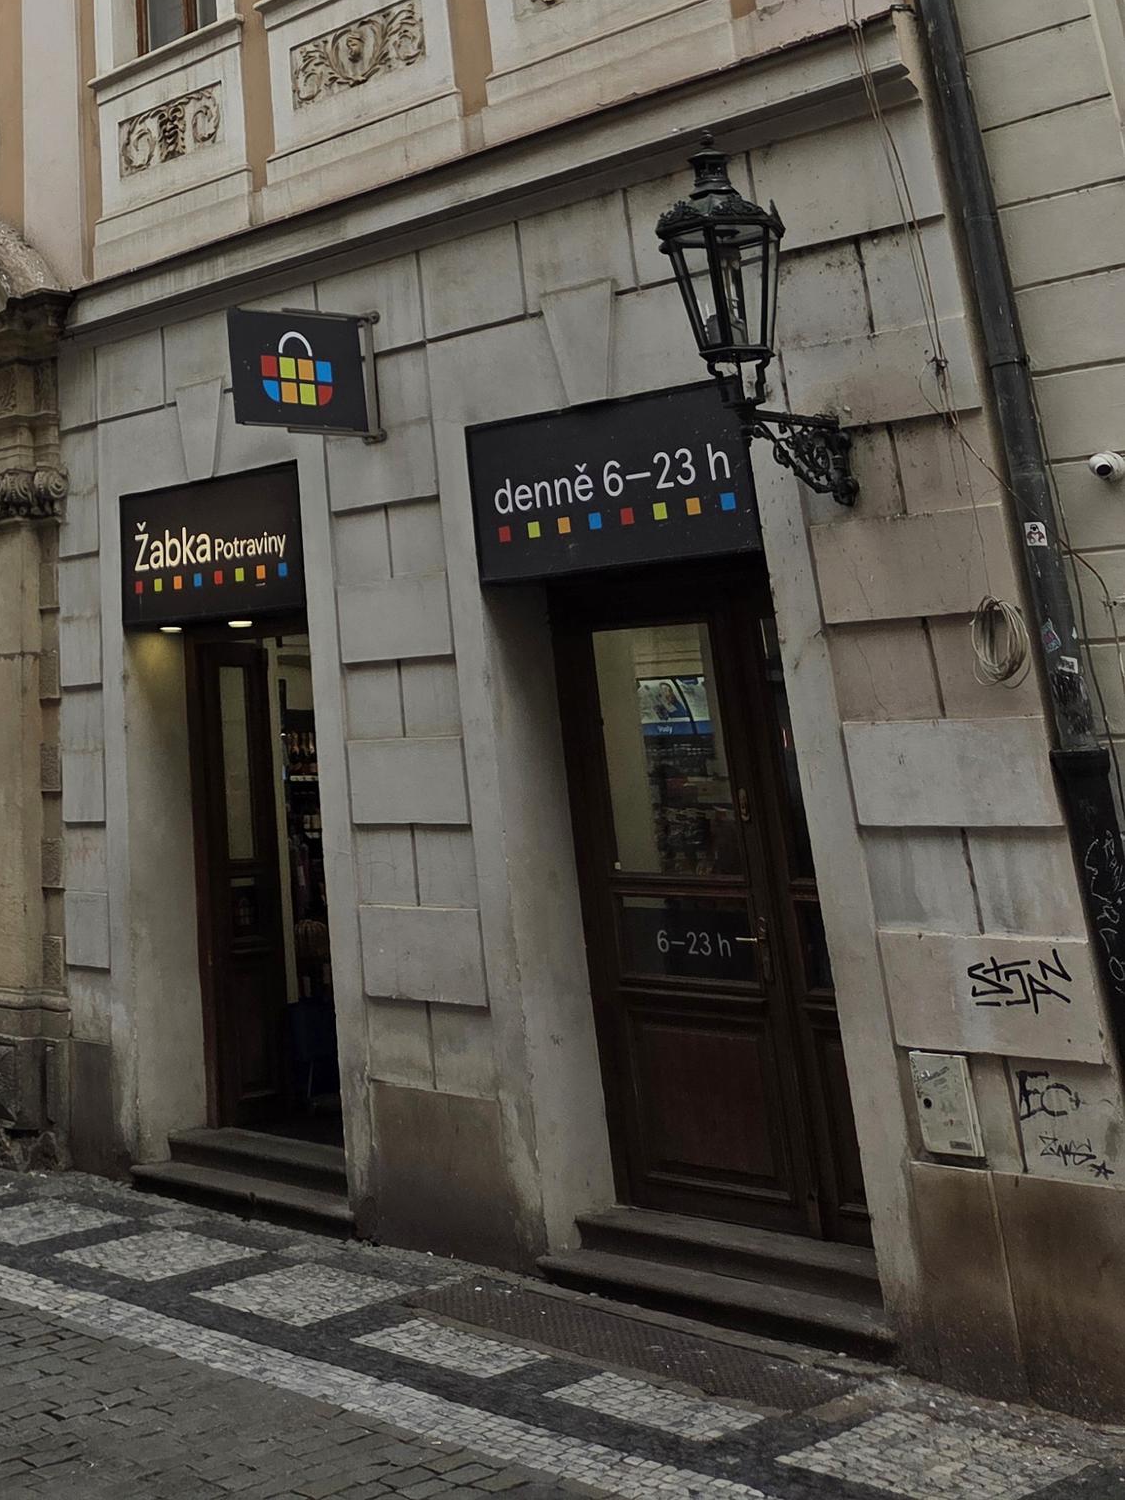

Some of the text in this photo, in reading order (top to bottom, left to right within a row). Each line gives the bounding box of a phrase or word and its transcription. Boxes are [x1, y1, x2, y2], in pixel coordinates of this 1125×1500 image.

[494, 463, 594, 515] denně
[706, 443, 731, 482] h
[134, 521, 286, 572] Žabka Potraviny
[717, 932, 732, 957] h
